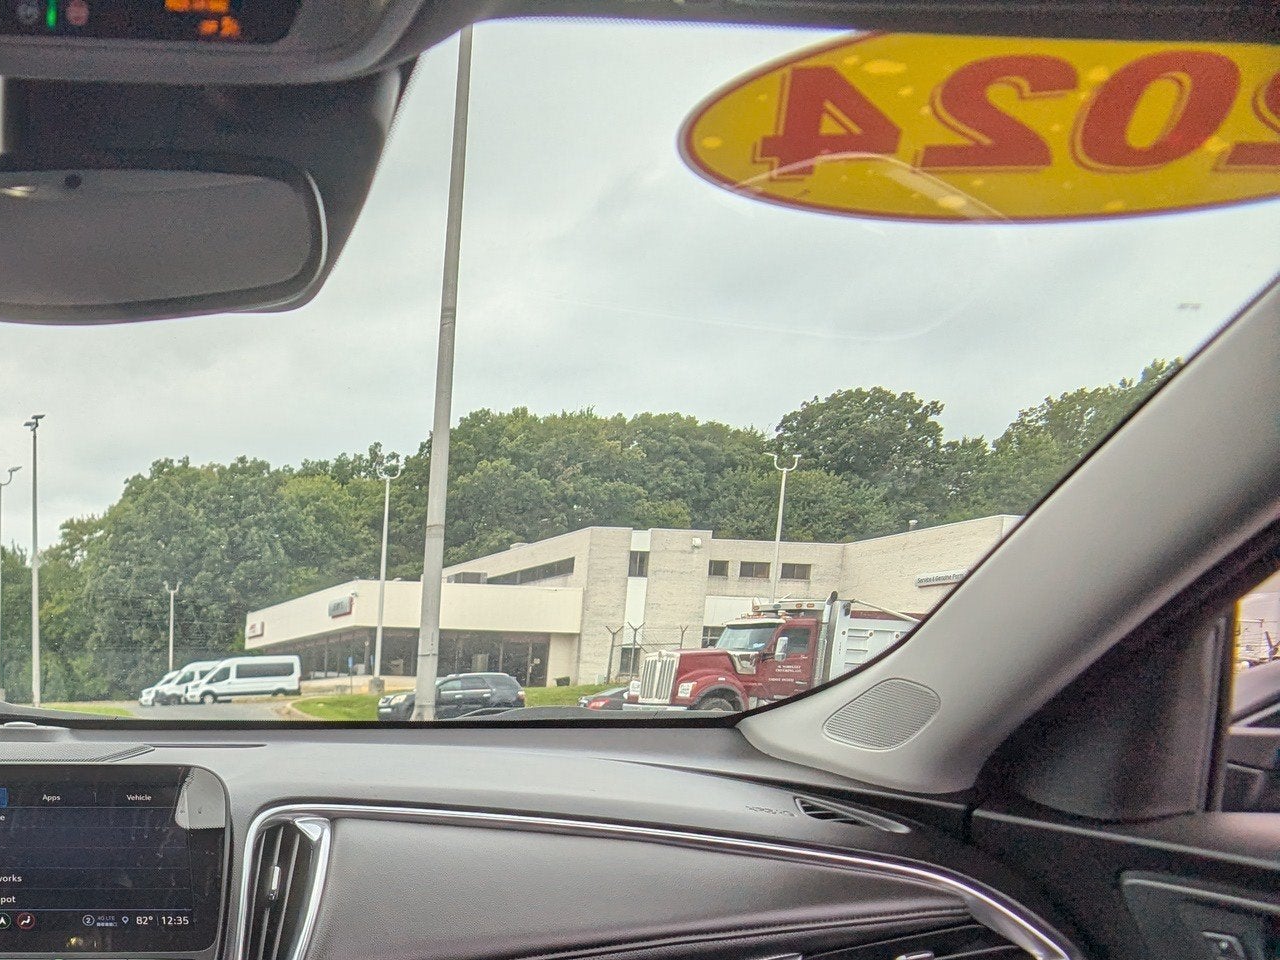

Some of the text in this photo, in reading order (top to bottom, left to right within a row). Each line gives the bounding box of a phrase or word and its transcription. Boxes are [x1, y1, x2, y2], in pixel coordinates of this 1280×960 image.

[42, 793, 61, 803] Apps
[126, 793, 152, 801] Vehicle
[161, 916, 189, 925] 12:35
